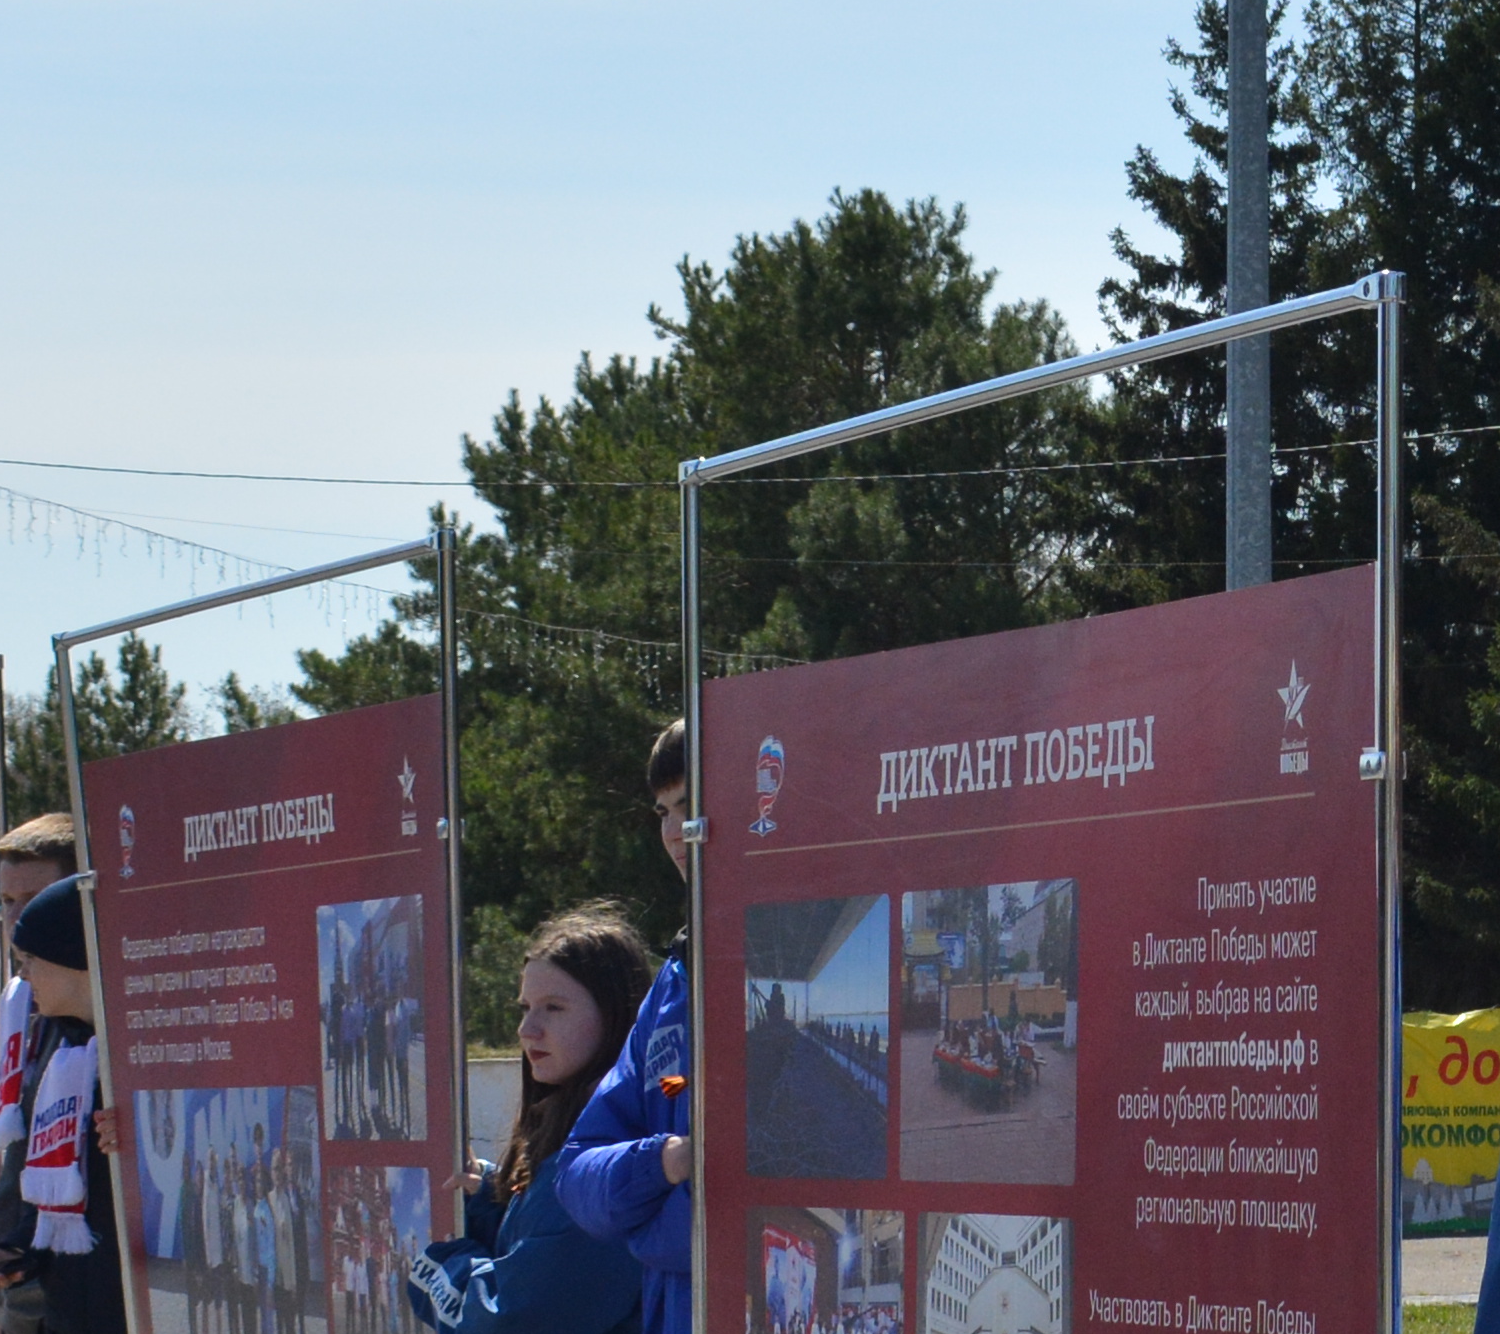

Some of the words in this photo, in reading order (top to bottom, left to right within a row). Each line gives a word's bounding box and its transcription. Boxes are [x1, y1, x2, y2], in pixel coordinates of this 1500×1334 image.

[877, 736, 1017, 814] ДИКТАНТ
[1023, 715, 1154, 788] ПОБЕДЫ
[184, 805, 258, 863] ДИКТАНТ
[261, 793, 335, 845] ПОБЕДЫ
[1198, 877, 1255, 917] Принять
[1259, 876, 1316, 915] участие
[1133, 942, 1140, 966] в
[1144, 933, 1206, 969] Диктанте
[1211, 926, 1266, 965] Победы
[1271, 931, 1317, 958] может
[1136, 982, 1192, 1020] каждый,
[1196, 980, 1249, 1022] выбрав
[1254, 986, 1271, 1013] на
[1276, 977, 1317, 1012] сайте
[1163, 1030, 1305, 1074] диктантпобеды.рф
[1310, 1040, 1318, 1065] в
[1118, 1087, 1159, 1119] своём
[1164, 1086, 1226, 1127] субъекте
[1231, 1085, 1318, 1120] Российской
[1144, 1136, 1223, 1179] Федерации
[1229, 1138, 1318, 1183] ближайшую
[1136, 1196, 1235, 1233] региональную
[1241, 1199, 1317, 1238] площадку.
[1089, 1289, 1171, 1327] Участвовать
[1175, 1302, 1182, 1328] в
[1186, 1295, 1251, 1334] Диктанте
